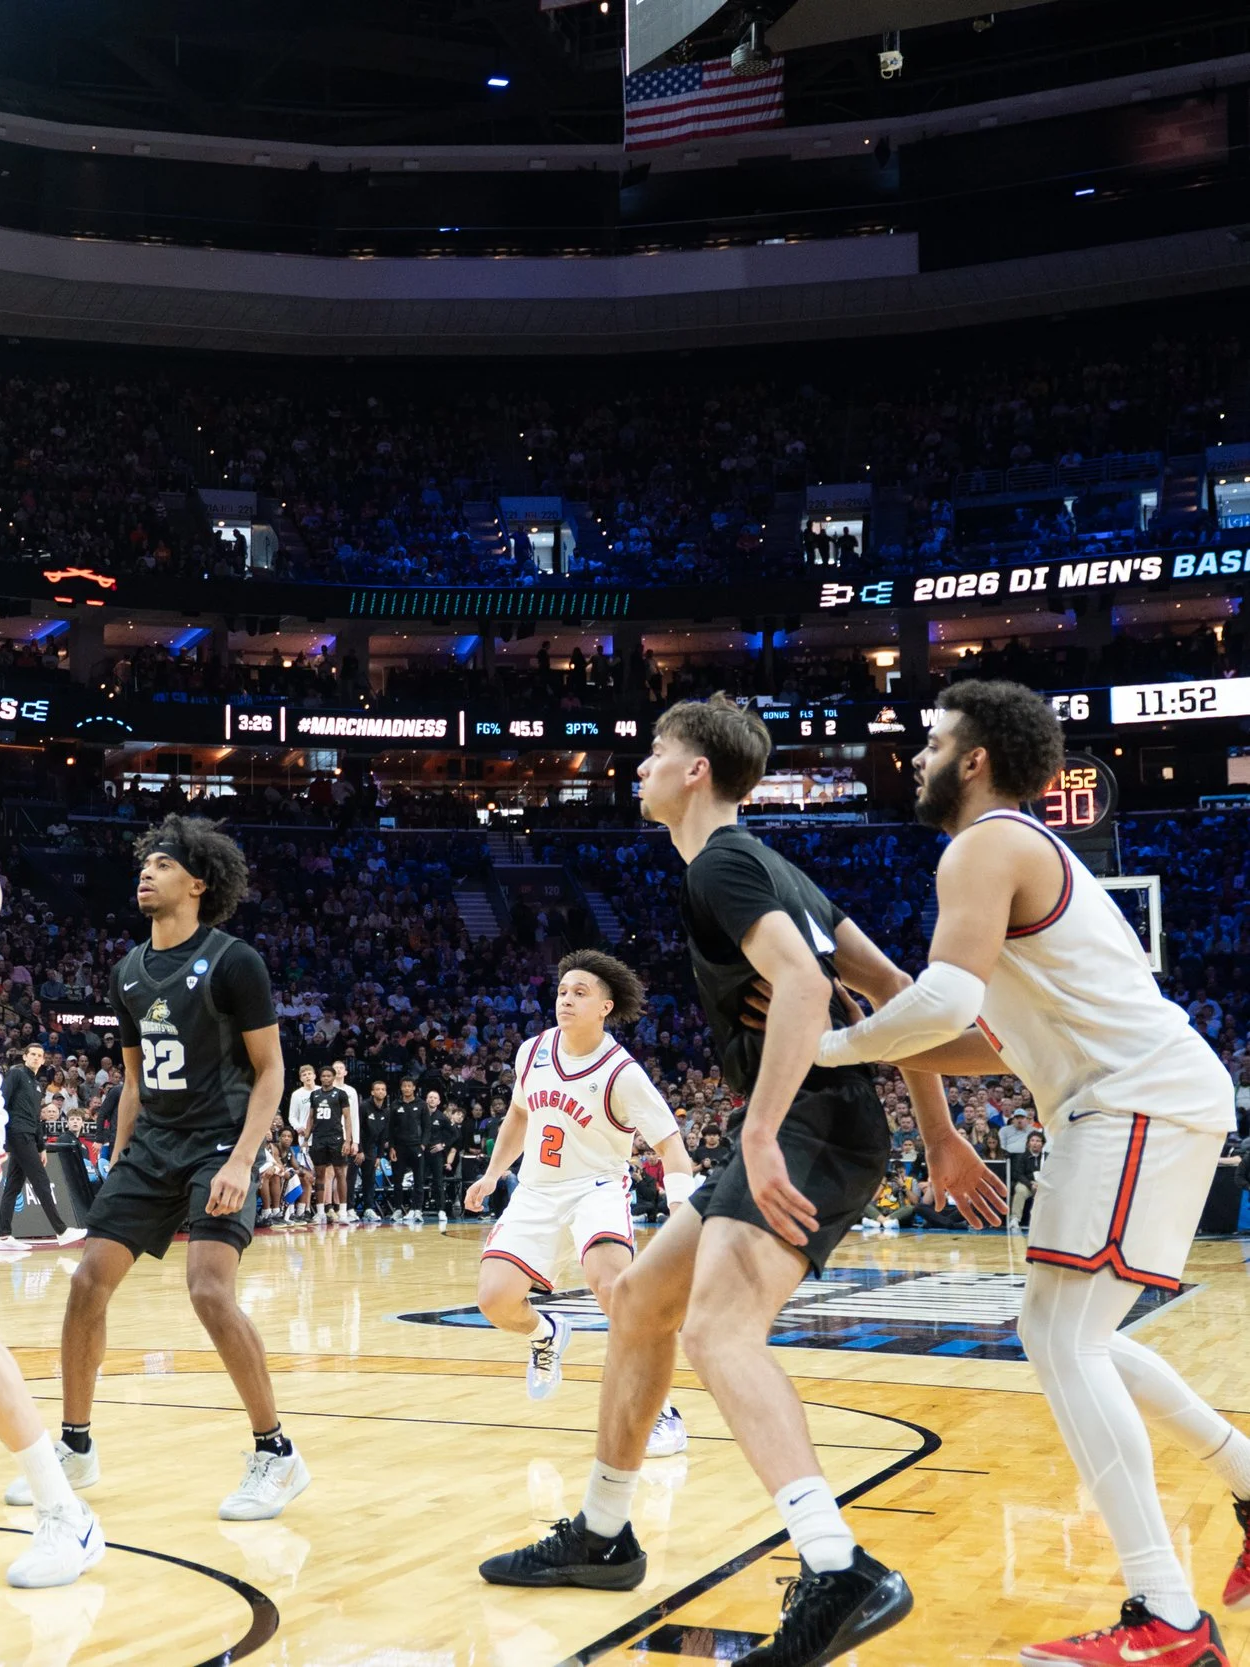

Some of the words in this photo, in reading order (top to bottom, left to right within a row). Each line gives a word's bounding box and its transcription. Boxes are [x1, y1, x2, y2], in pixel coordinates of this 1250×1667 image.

[913, 571, 1000, 602] 2026
[1009, 566, 1049, 593] DI
[1058, 556, 1162, 588] MEN'S
[763, 711, 790, 720] BONUS
[800, 710, 814, 719] FLS
[824, 709, 838, 718] TOL
[1136, 686, 1217, 717] 11:52
[238, 714, 272, 731] 3:26
[298, 716, 447, 738] #MARCHMADNESS
[476, 722, 501, 735] FG%
[509, 720, 544, 737] 45.5
[565, 722, 598, 735] 3PT%
[614, 720, 637, 737] 44
[800, 720, 812, 736] 5
[825, 720, 837, 736] 2
[1044, 789, 1094, 825] 30
[141, 1038, 187, 1090] 22
[316, 1107, 331, 1120] 20
[527, 1090, 593, 1129] VIRGINIA
[539, 1124, 565, 1168] 2
